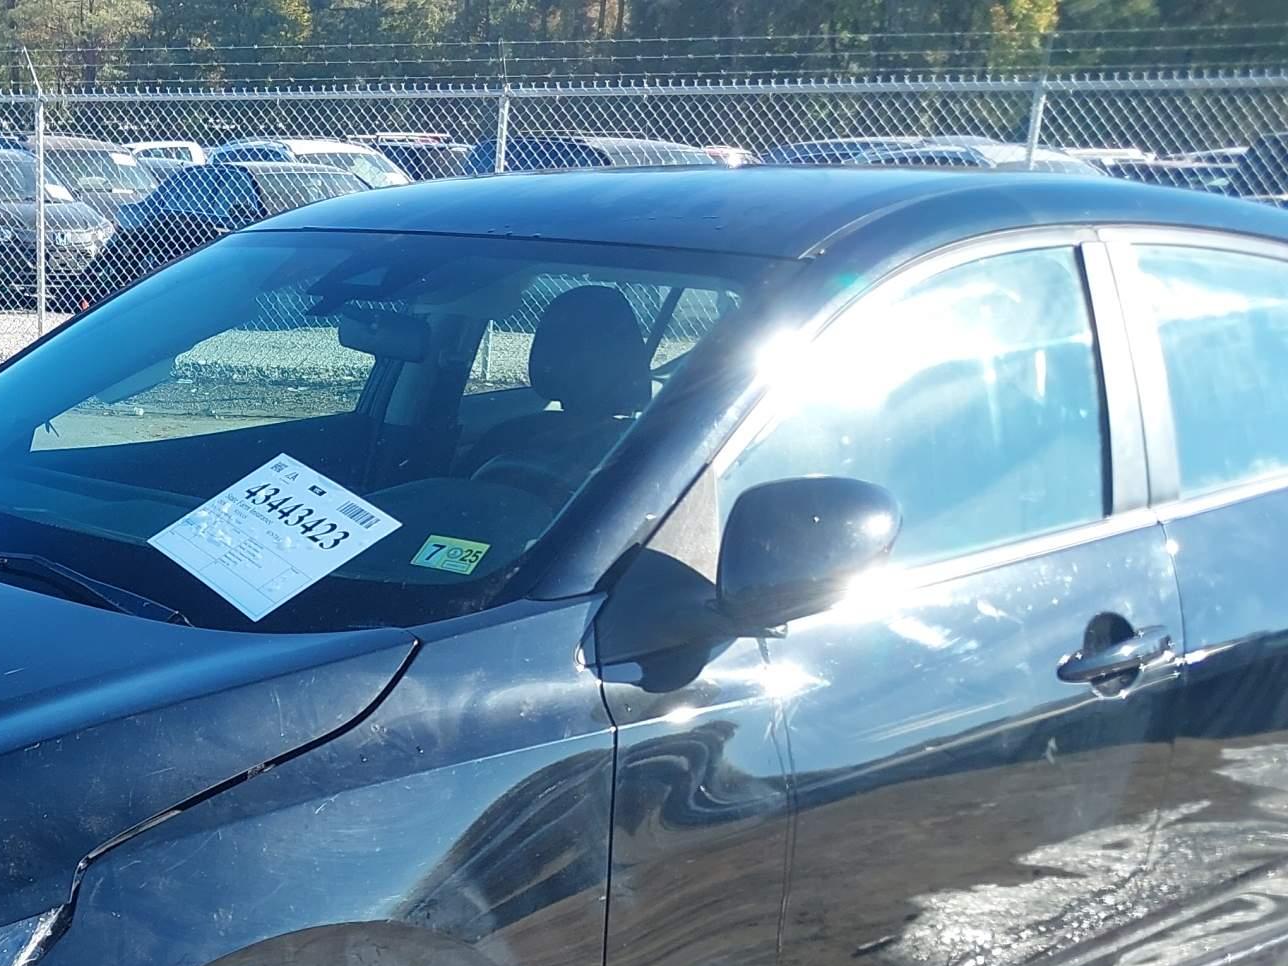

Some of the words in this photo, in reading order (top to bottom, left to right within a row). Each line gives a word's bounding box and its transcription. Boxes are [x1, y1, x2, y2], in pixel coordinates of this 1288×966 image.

[244, 483, 350, 550] 43443423
[425, 544, 447, 561] 7
[459, 549, 483, 564] 25
